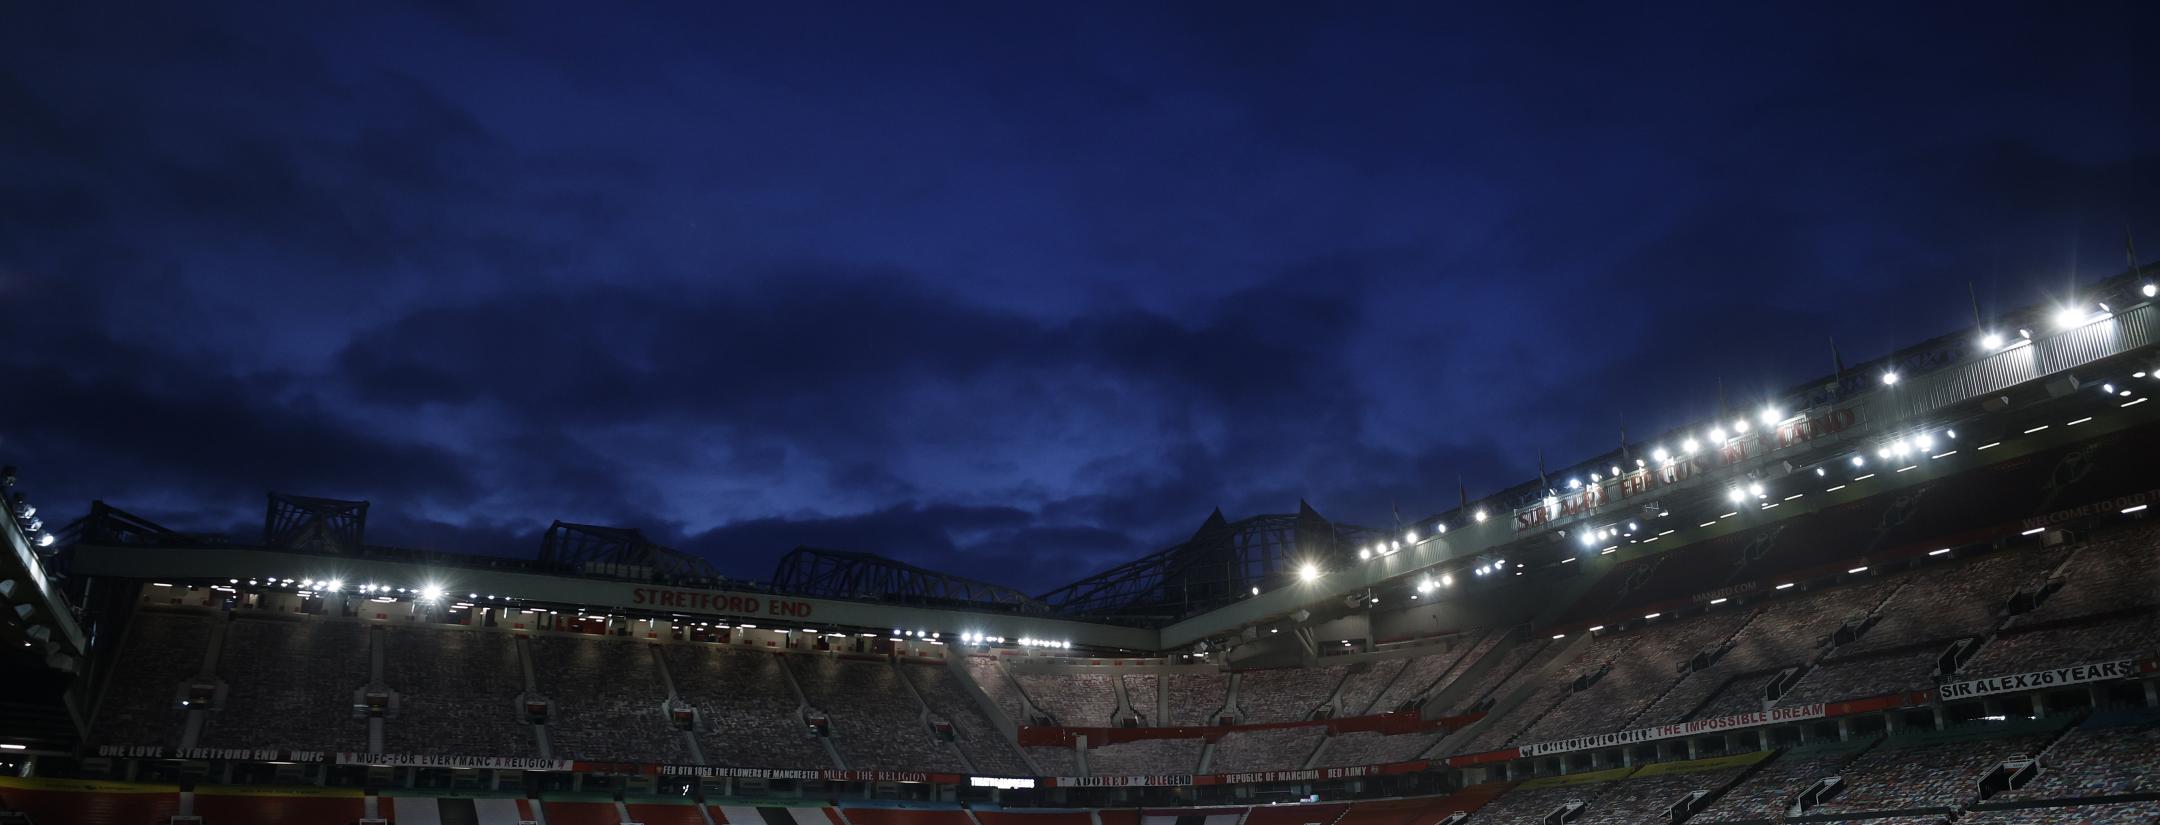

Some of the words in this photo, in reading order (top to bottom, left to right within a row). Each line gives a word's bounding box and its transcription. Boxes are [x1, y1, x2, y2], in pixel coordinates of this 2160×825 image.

[1517, 507, 1548, 531] SIR
[2022, 505, 2089, 529] WELCOME
[2094, 500, 2112, 513] TO
[2116, 494, 2145, 509] OLD
[633, 588, 760, 614] STRETFORD
[768, 599, 812, 618] END
[1941, 683, 1971, 698] SIR
[1976, 674, 2028, 693] ALEX
[2030, 671, 2054, 686] 26
[2057, 660, 2130, 682] YEARS
[1657, 725, 1681, 737] THE
[1685, 712, 1767, 733] IMPOSSIBLE
[1772, 703, 1823, 721] DREAM
[98, 745, 127, 757] ONE
[129, 746, 164, 758] LOVE
[175, 747, 251, 760] STRETFORD
[254, 749, 279, 761] END
[290, 750, 325, 762] MUFC
[495, 756, 502, 767] A
[504, 757, 555, 769] RELIGION
[715, 767, 729, 777] THE
[730, 767, 762, 778] FLOWERS
[763, 768, 772, 779] OF
[772, 768, 819, 779] MANCHESTER
[823, 769, 849, 780] MUFC
[856, 770, 874, 781] THE
[878, 770, 928, 783] RELIGION
[1074, 776, 1129, 787] ADORED
[1226, 772, 1264, 784] REPUBLIC
[1265, 771, 1275, 782] OF
[1278, 769, 1320, 782] MANCUNIA
[1327, 768, 1343, 778] RED
[1344, 766, 1367, 777] ARMY
